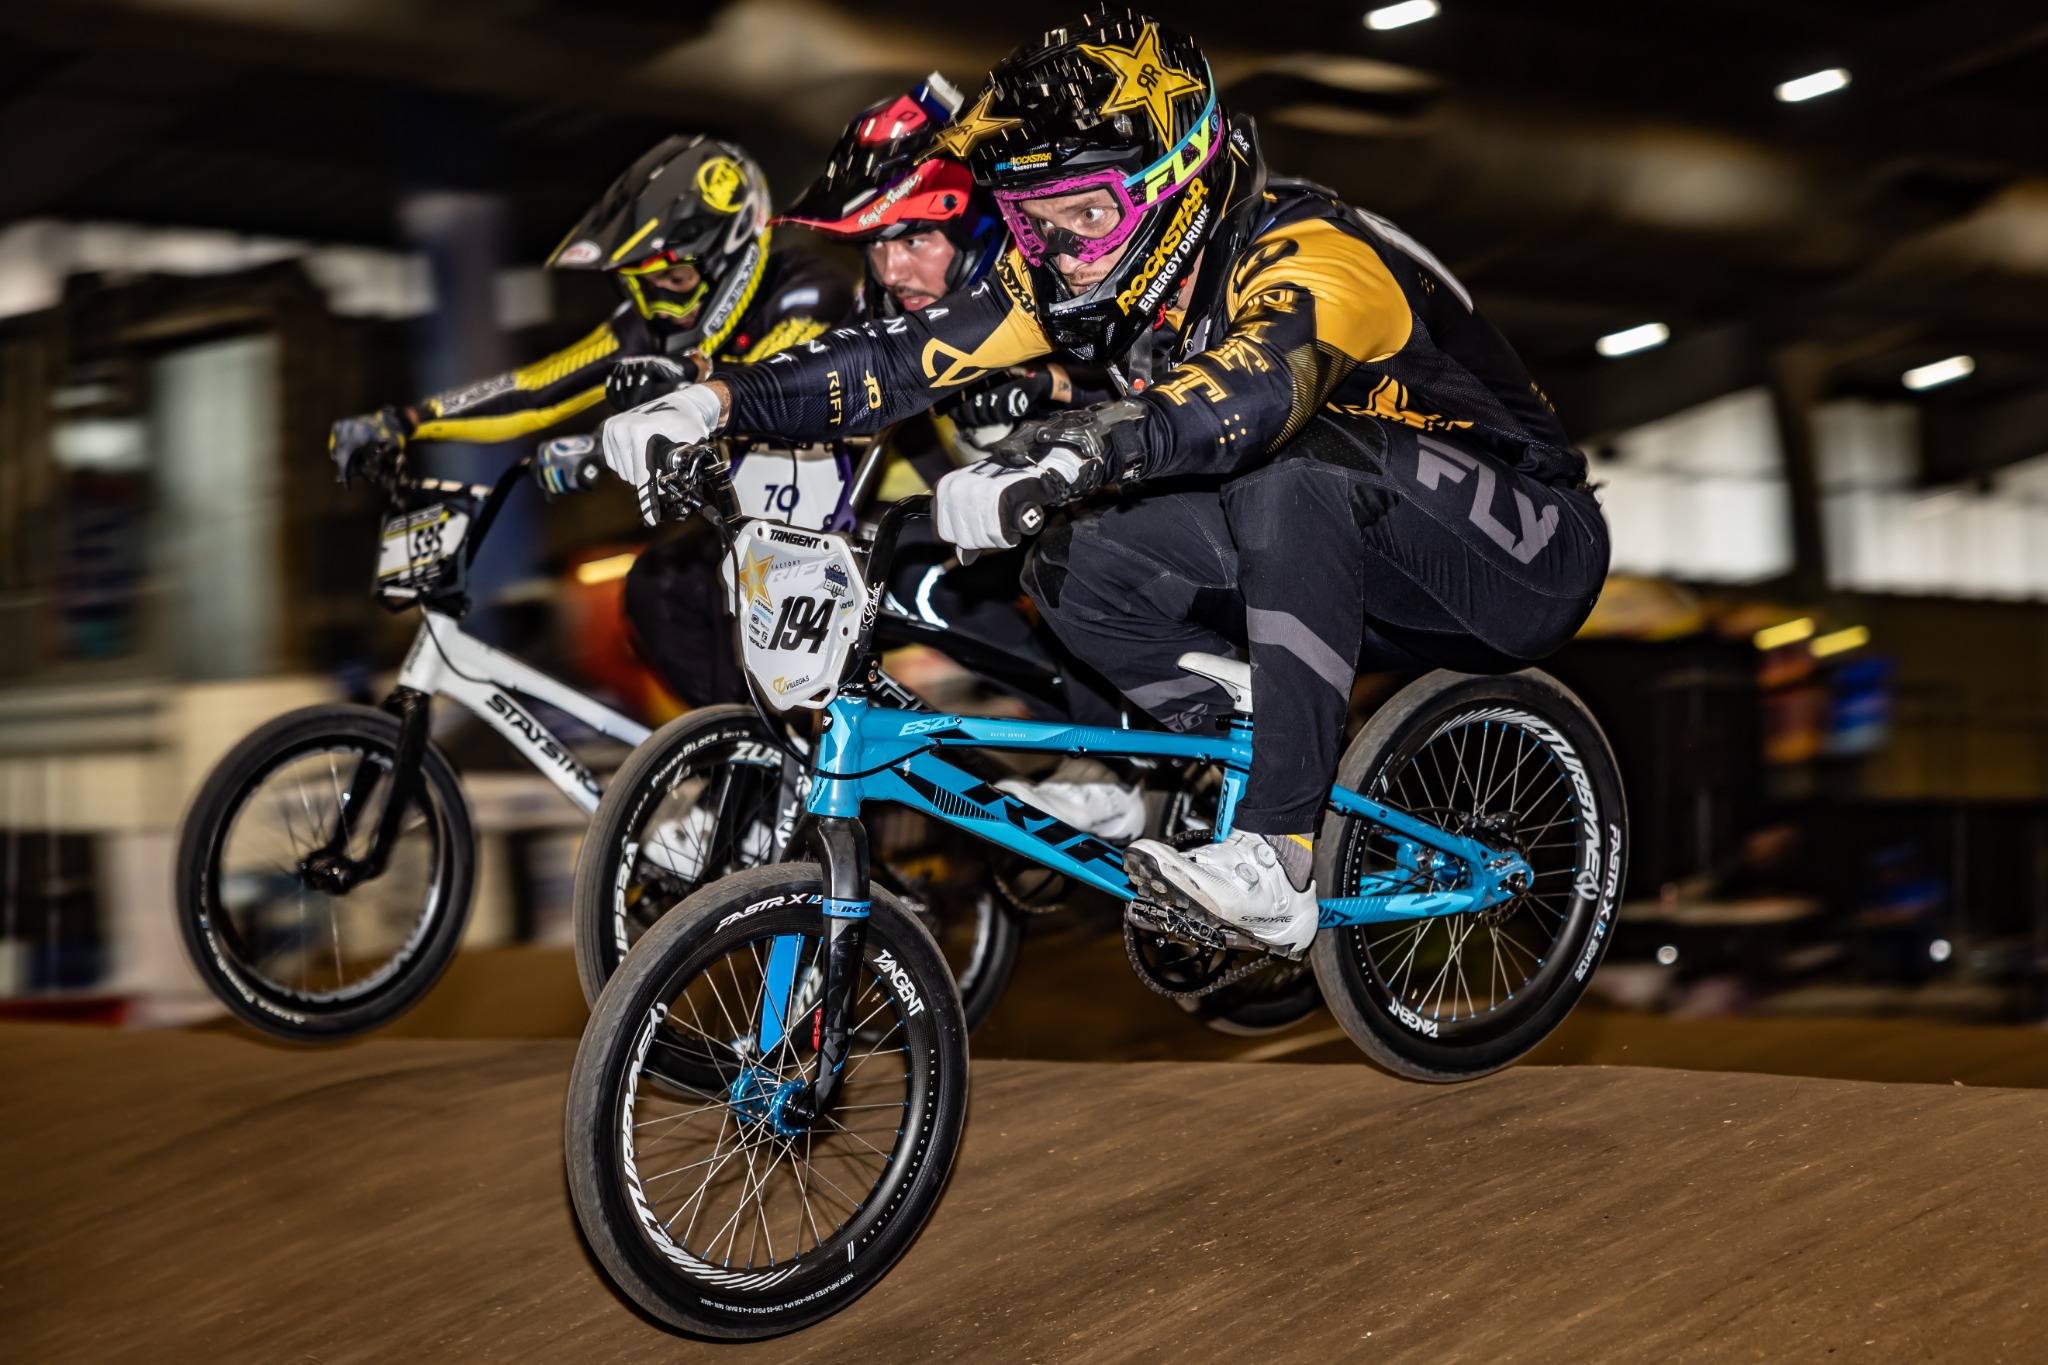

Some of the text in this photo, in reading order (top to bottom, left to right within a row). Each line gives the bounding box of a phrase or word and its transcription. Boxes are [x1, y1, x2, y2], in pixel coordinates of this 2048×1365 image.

[1144, 116, 1210, 205] FLY
[1116, 177, 1209, 317] ROCKSTAR
[1138, 204, 1210, 313] ENERGY DRINK
[827, 370, 842, 425] RIFT
[764, 484, 800, 512] 70
[1416, 434, 1559, 566] FLY
[769, 528, 821, 549] TANGENT
[771, 560, 800, 570] FACTORY
[824, 579, 846, 597] BMX
[767, 596, 837, 654] 194
[786, 675, 810, 690] VILLEGAS
[1605, 823, 1621, 898] FASTR
[714, 892, 809, 934] FASTR X
[1600, 899, 1613, 922] X
[873, 949, 925, 1017] TANGENT
[1388, 997, 1439, 1039] TANGENT
[897, 1139, 925, 1199] CARBON
[862, 1204, 895, 1243] FIBER
[815, 1279, 840, 1298] INFLATED
[840, 1272, 854, 1285] KEEP
